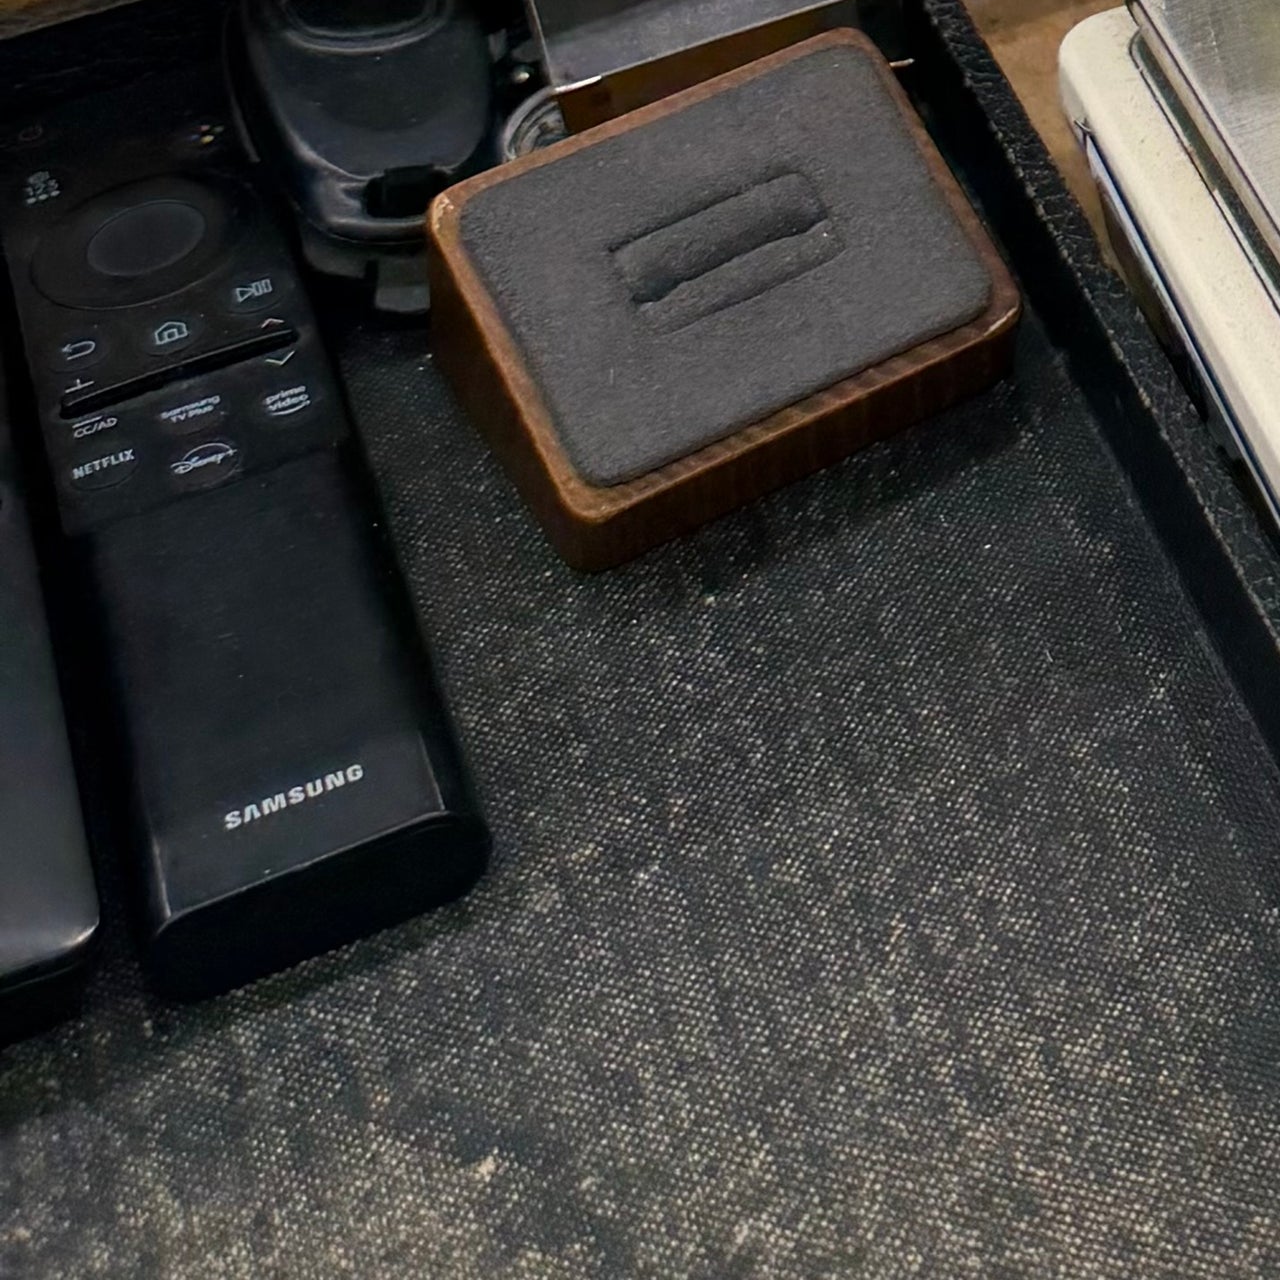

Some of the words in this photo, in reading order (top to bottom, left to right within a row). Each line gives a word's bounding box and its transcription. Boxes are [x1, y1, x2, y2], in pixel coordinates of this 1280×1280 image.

[73, 417, 118, 439] CC/AD
[72, 448, 135, 481] NETFLIX
[224, 764, 364, 830] SAMSUNG
